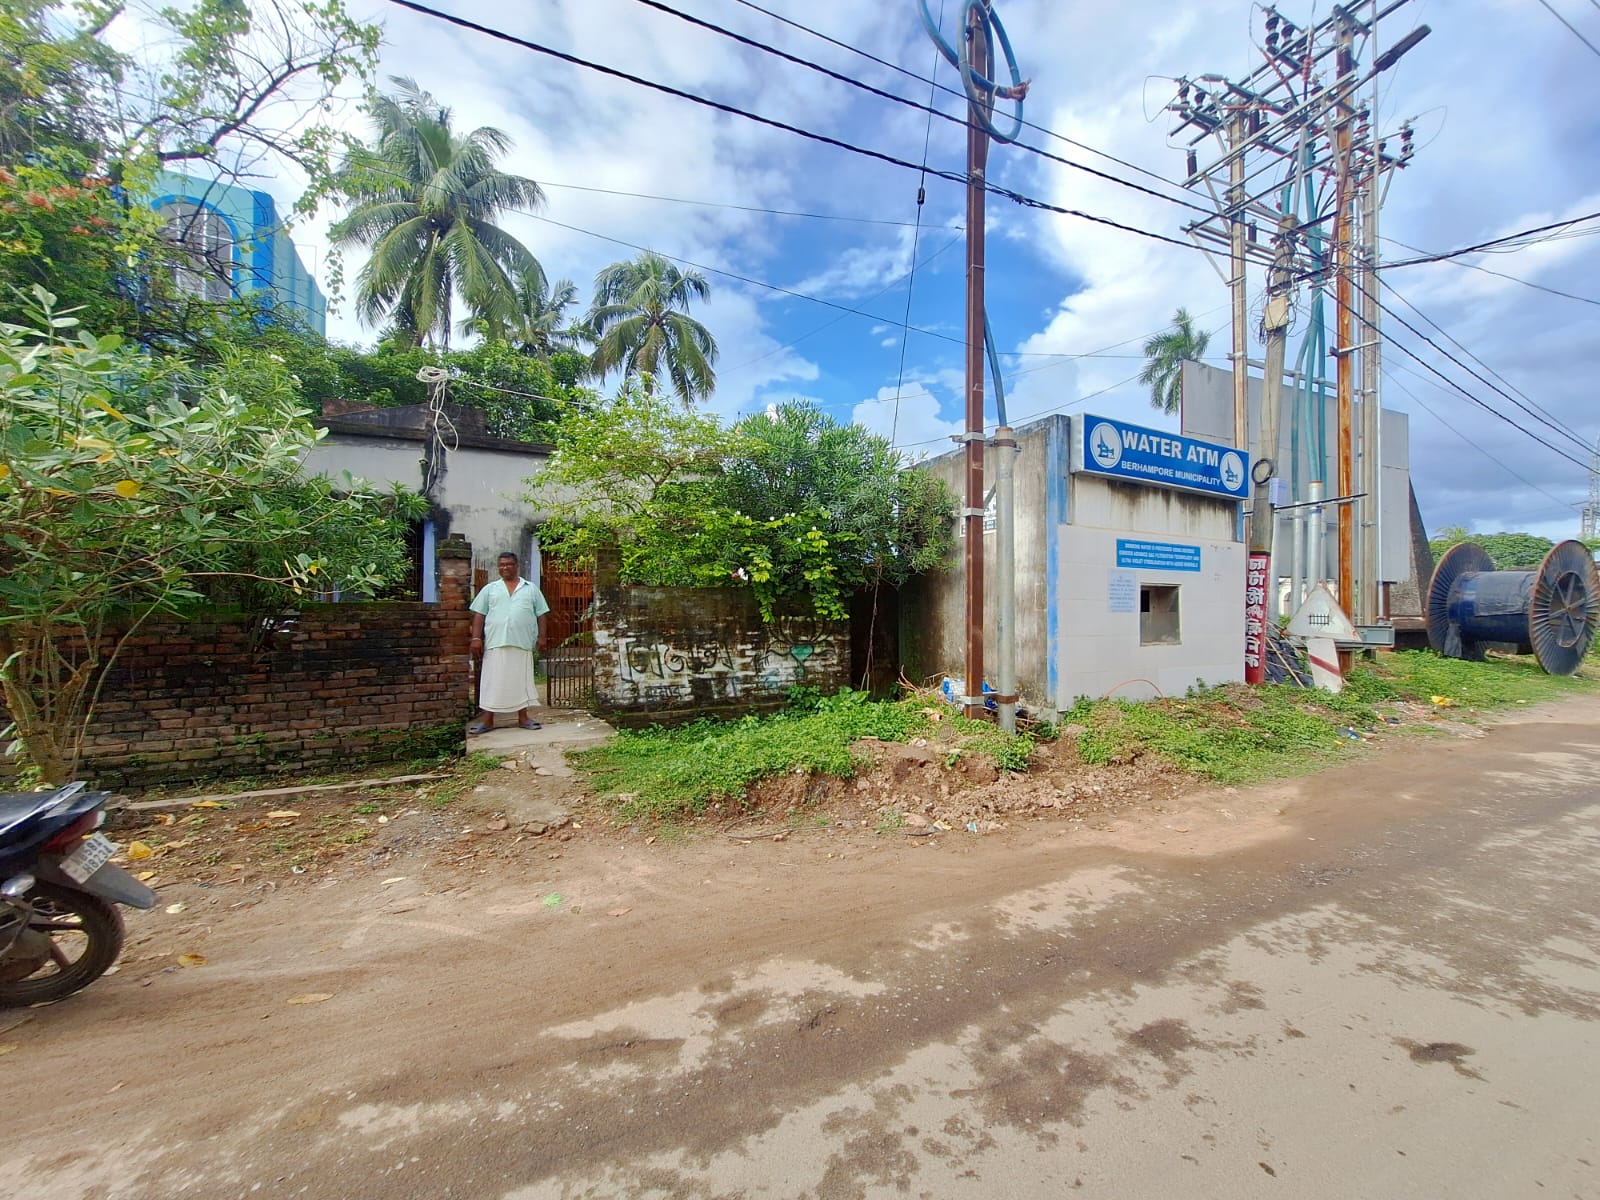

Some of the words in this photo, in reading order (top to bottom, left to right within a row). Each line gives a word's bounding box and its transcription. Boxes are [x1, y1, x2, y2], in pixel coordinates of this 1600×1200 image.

[1122, 430, 1182, 460] WATER
[1186, 445, 1219, 467] ATM
[1121, 460, 1174, 478] BERHAMPORE
[1175, 470, 1221, 487] MUNICIPALITY
